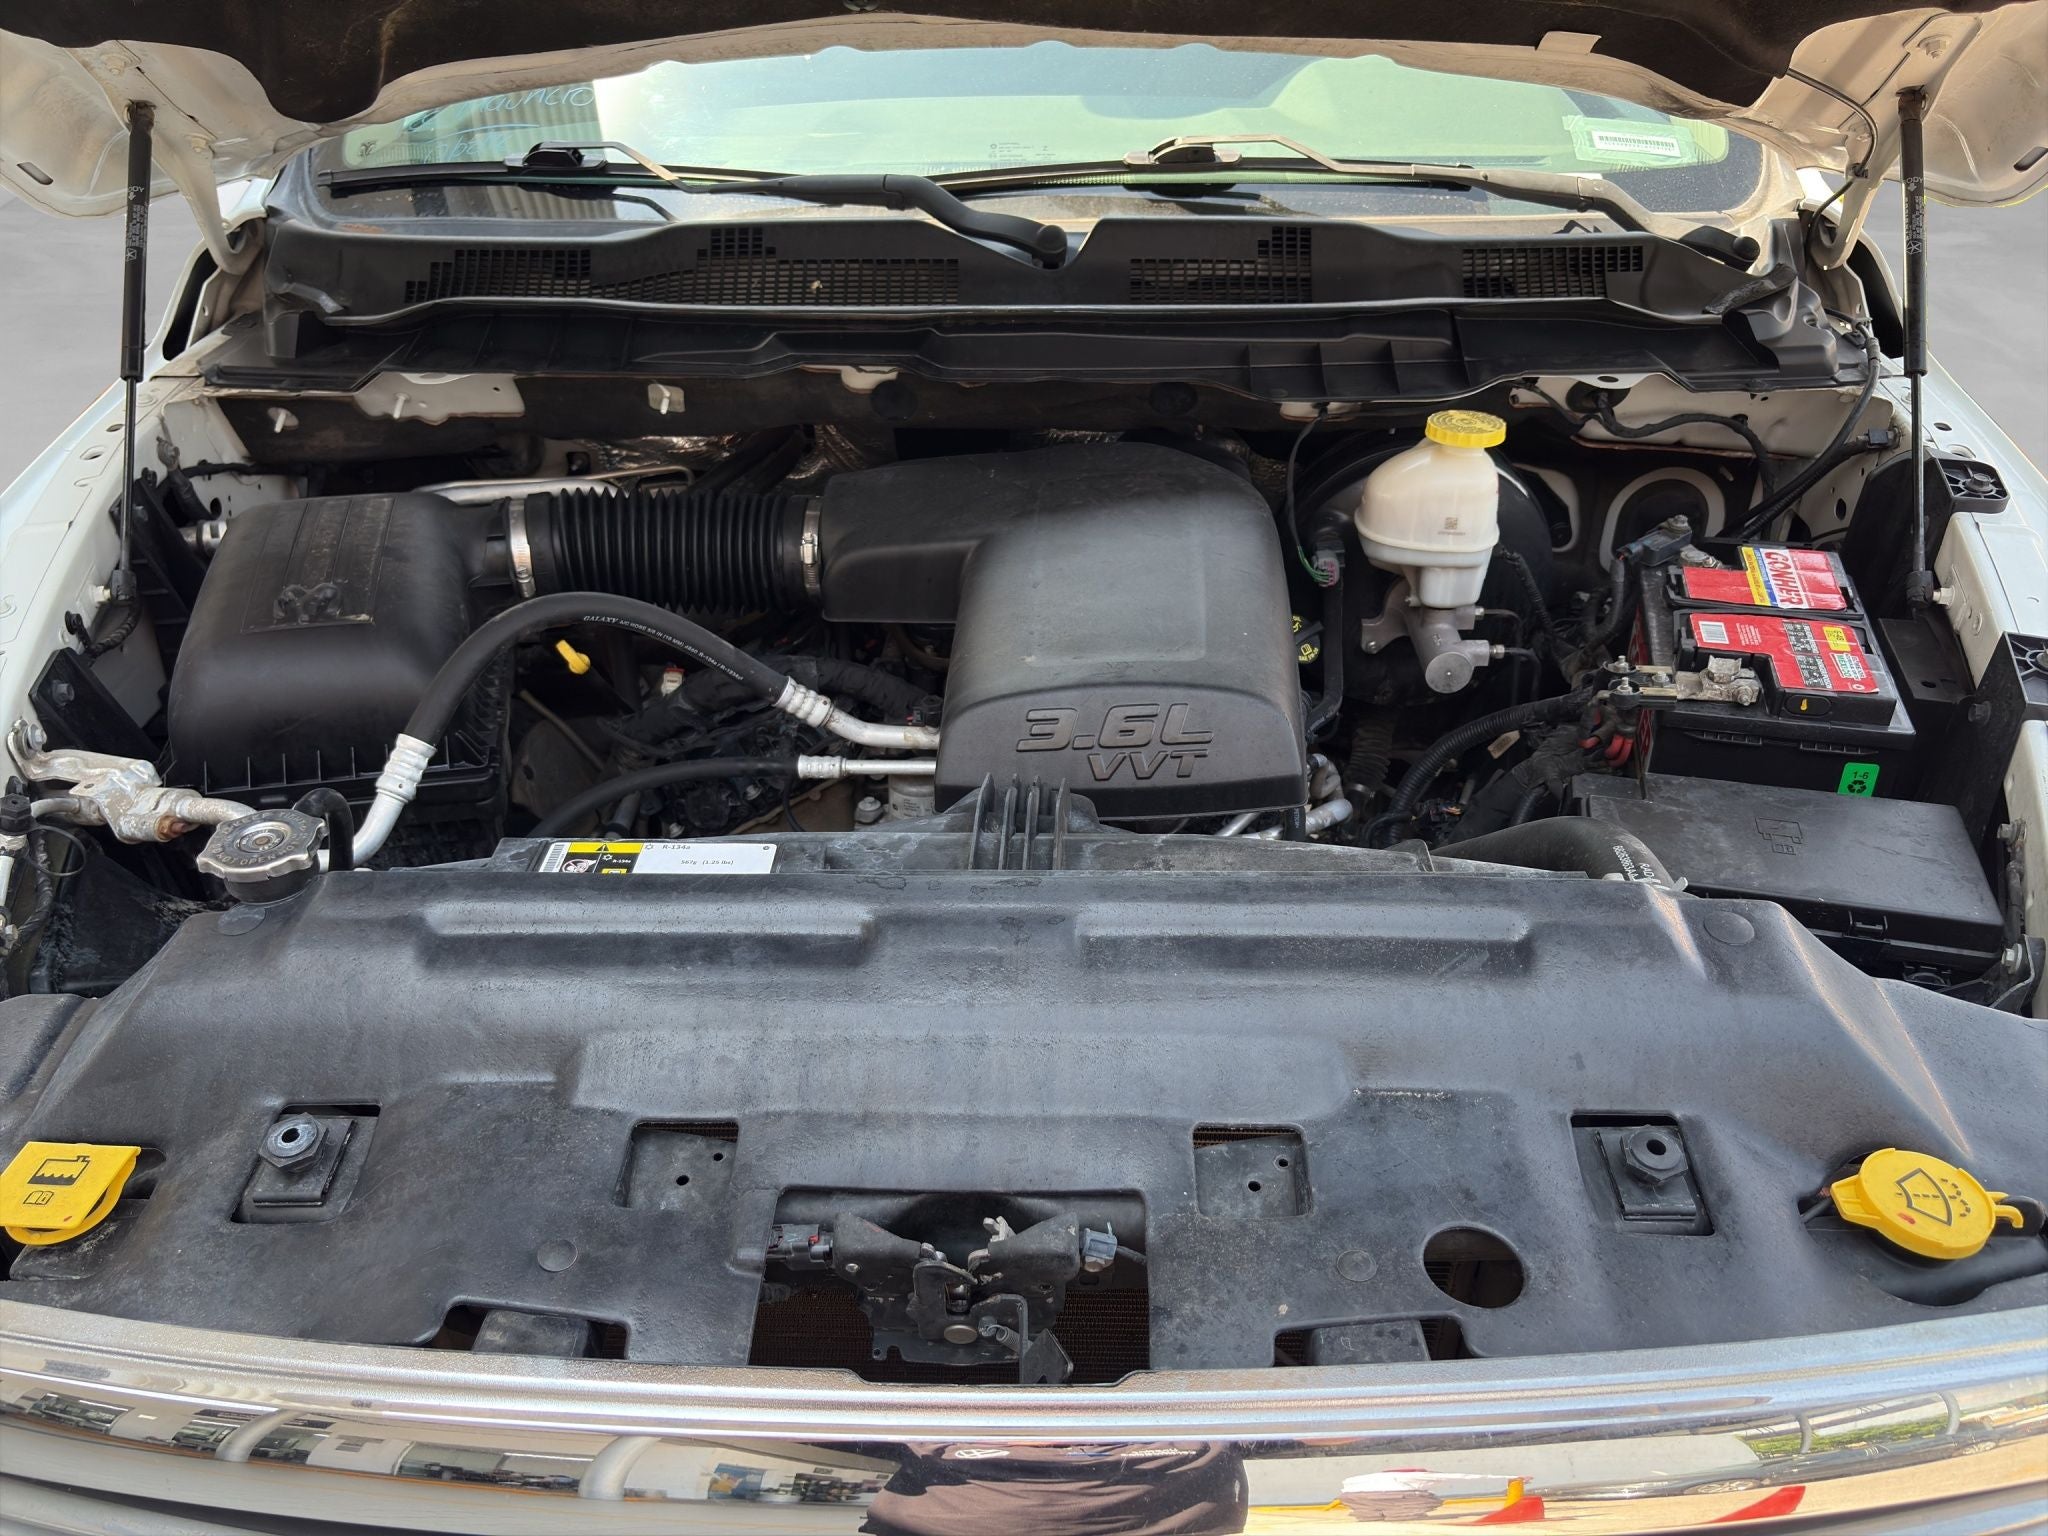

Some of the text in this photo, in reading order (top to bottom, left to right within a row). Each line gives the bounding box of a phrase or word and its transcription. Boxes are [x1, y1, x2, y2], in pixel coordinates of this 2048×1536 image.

[1764, 551, 1804, 605] GONHER
[583, 615, 619, 624] GALAXY
[630, 622, 647, 631] HOSE
[1016, 703, 1214, 752] 3.6L
[1088, 749, 1209, 781] VVT
[1853, 771, 1869, 779] 1-6
[238, 853, 277, 865] OPEN
